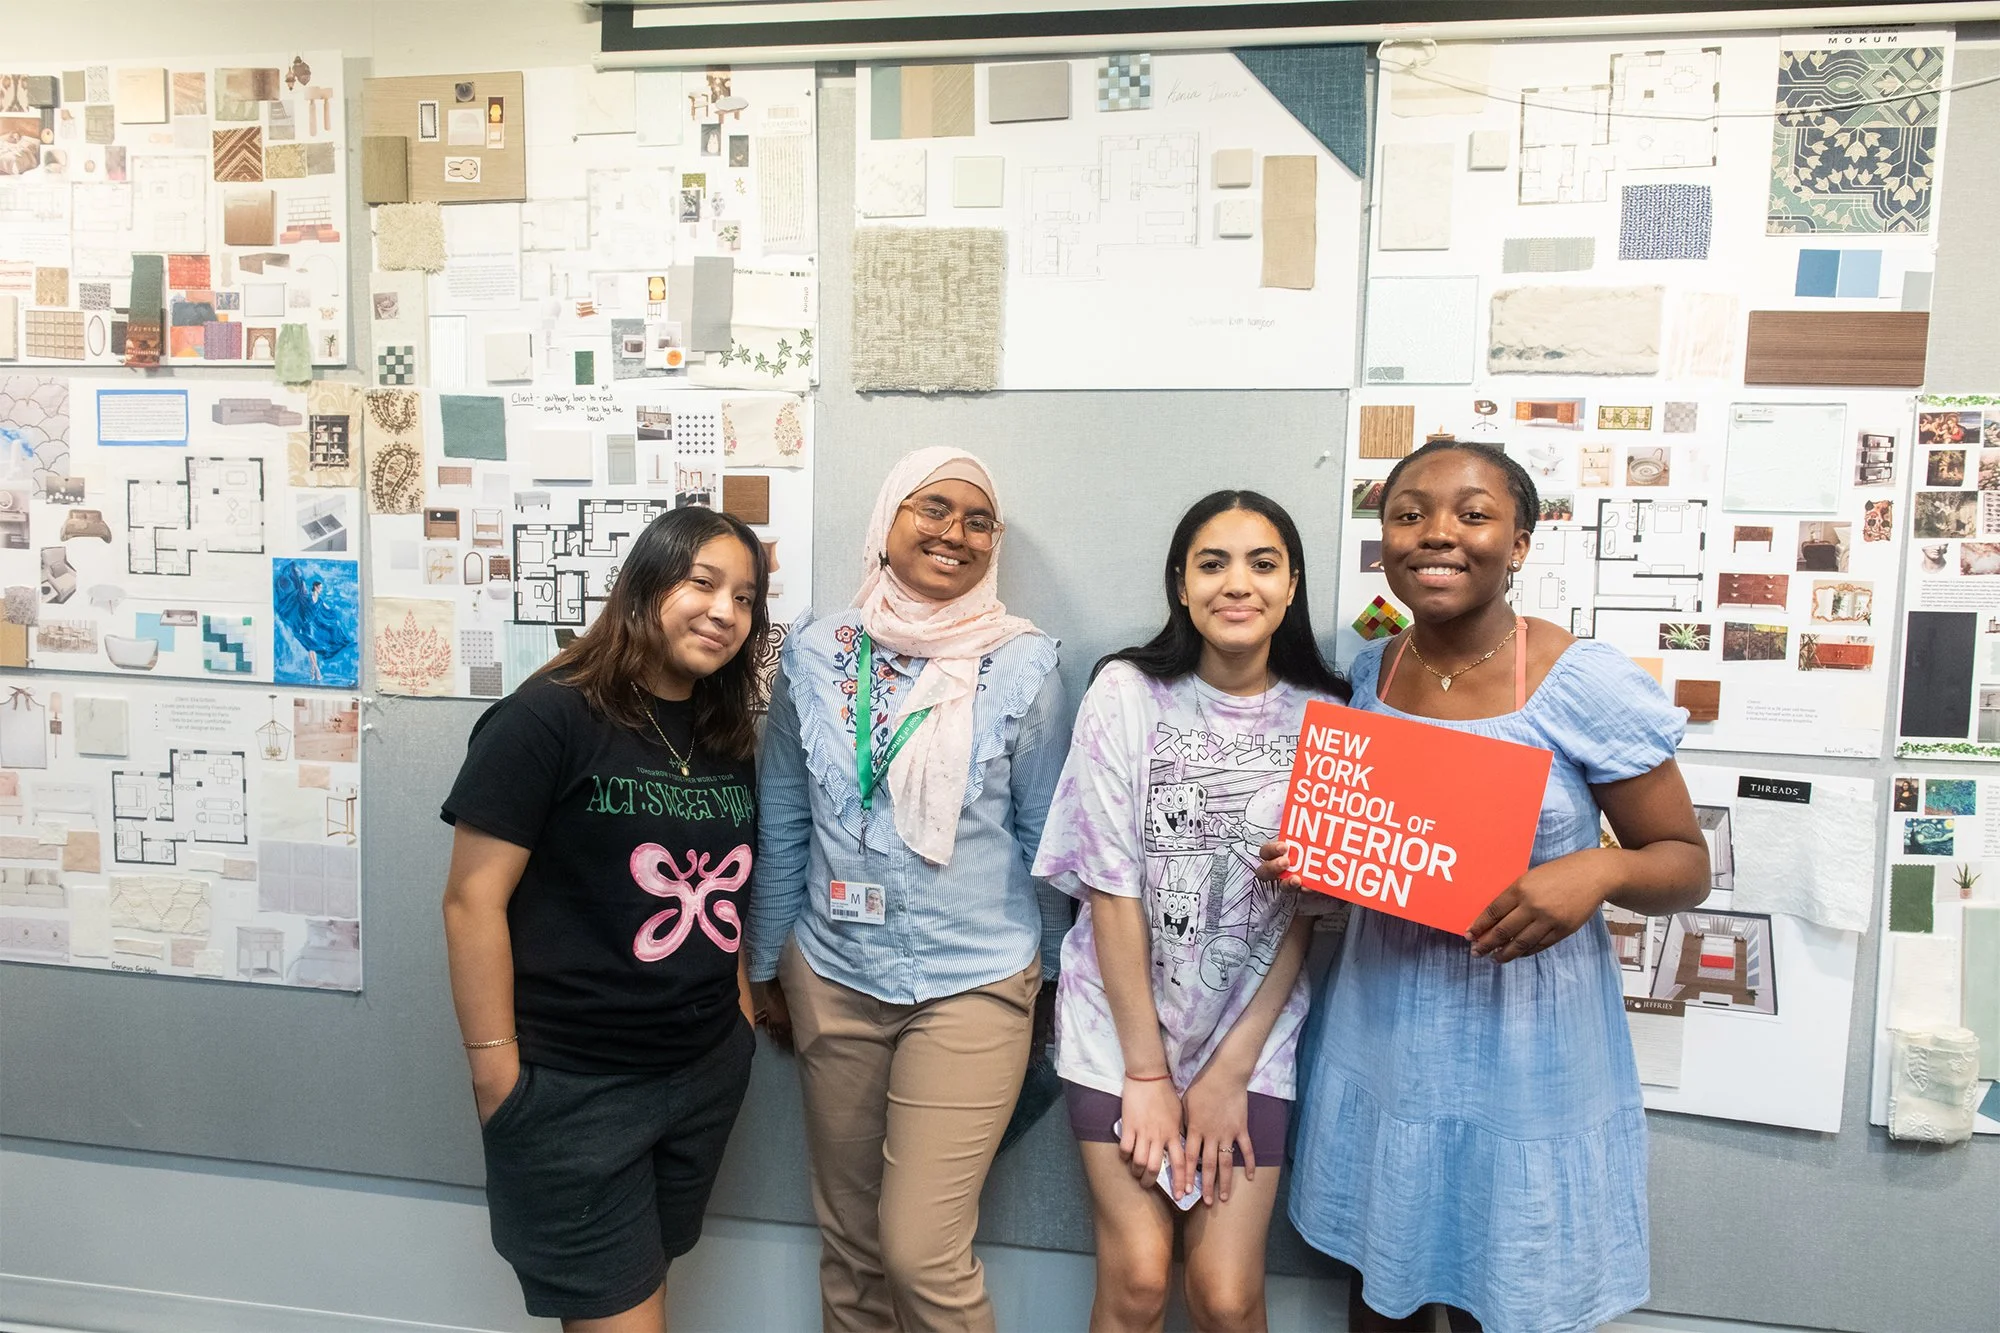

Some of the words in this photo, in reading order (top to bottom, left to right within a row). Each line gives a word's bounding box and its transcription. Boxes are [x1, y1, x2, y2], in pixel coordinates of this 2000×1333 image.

[1828, 36, 1899, 44] MOKUM
[512, 392, 534, 404] Client
[544, 393, 571, 404] author,
[573, 393, 587, 402] loves
[599, 394, 614, 402] read
[544, 404, 562, 414] early
[603, 405, 612, 414] by
[613, 404, 624, 412] the
[587, 413, 605, 422] beach
[909, 710, 926, 729] School
[886, 735, 905, 760] Interior
[1154, 721, 1302, 767] スポンジ・ボ
[1305, 724, 1371, 760] NEW
[637, 766, 669, 778] TOMORROW
[697, 774, 718, 784] WORLD
[718, 773, 735, 782] TOUR
[1303, 751, 1375, 791] YORK
[1750, 783, 1800, 796] THREADS
[711, 785, 755, 828] MIRA
[1293, 778, 1401, 829] SCHOOL
[1407, 816, 1437, 836] OF
[1286, 804, 1458, 883] INTERIOR
[1286, 838, 1413, 908] DESIGN
[850, 893, 861, 905] M
[1643, 1001, 1673, 1010] JEFFRIES
